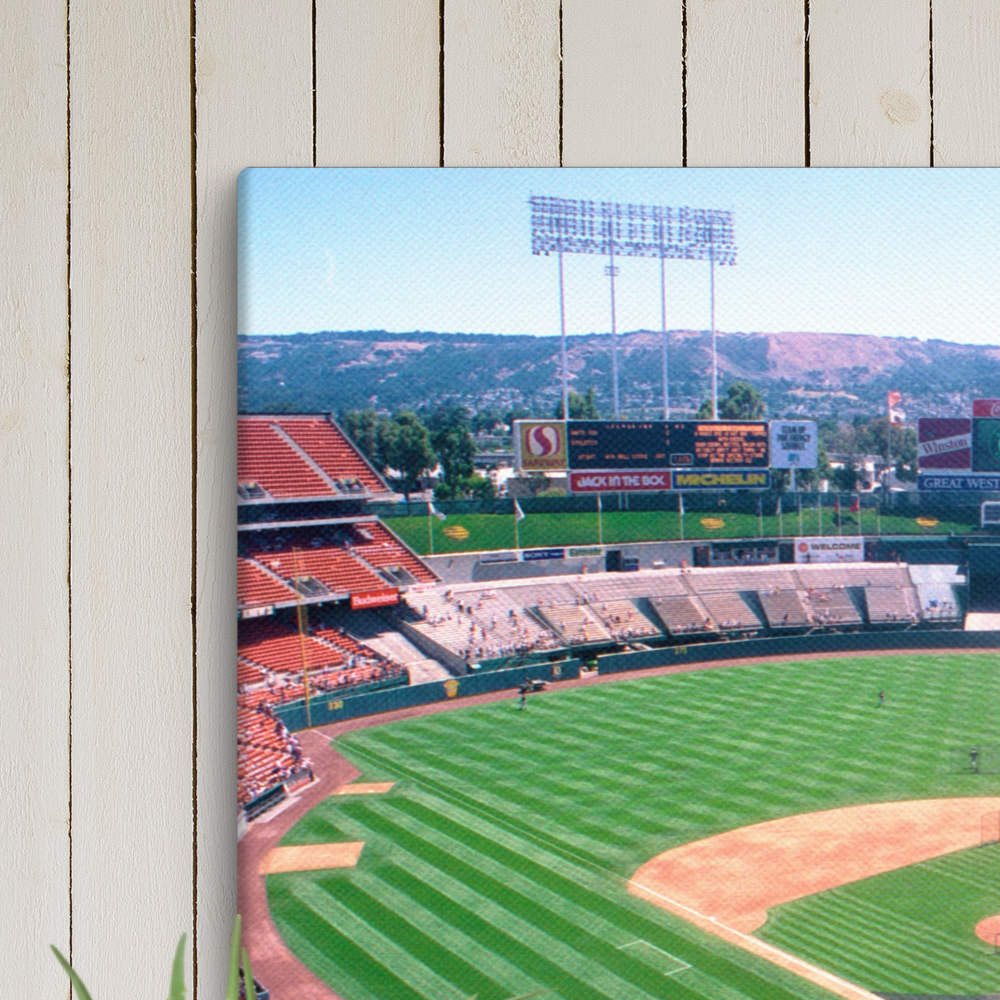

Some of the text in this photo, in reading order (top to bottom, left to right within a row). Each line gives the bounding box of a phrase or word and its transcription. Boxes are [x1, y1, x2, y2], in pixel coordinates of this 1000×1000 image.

[922, 436, 968, 455] Winston
[522, 458, 566, 468] SAFEWAY
[577, 477, 606, 488] JACK
[622, 477, 640, 486] THE
[642, 475, 666, 486] BOX
[676, 473, 766, 486] MICHELIN
[924, 478, 965, 489] GREAT
[811, 543, 862, 551] WELCOME
[525, 551, 549, 559] SONY
[353, 592, 398, 606] Budweiser
